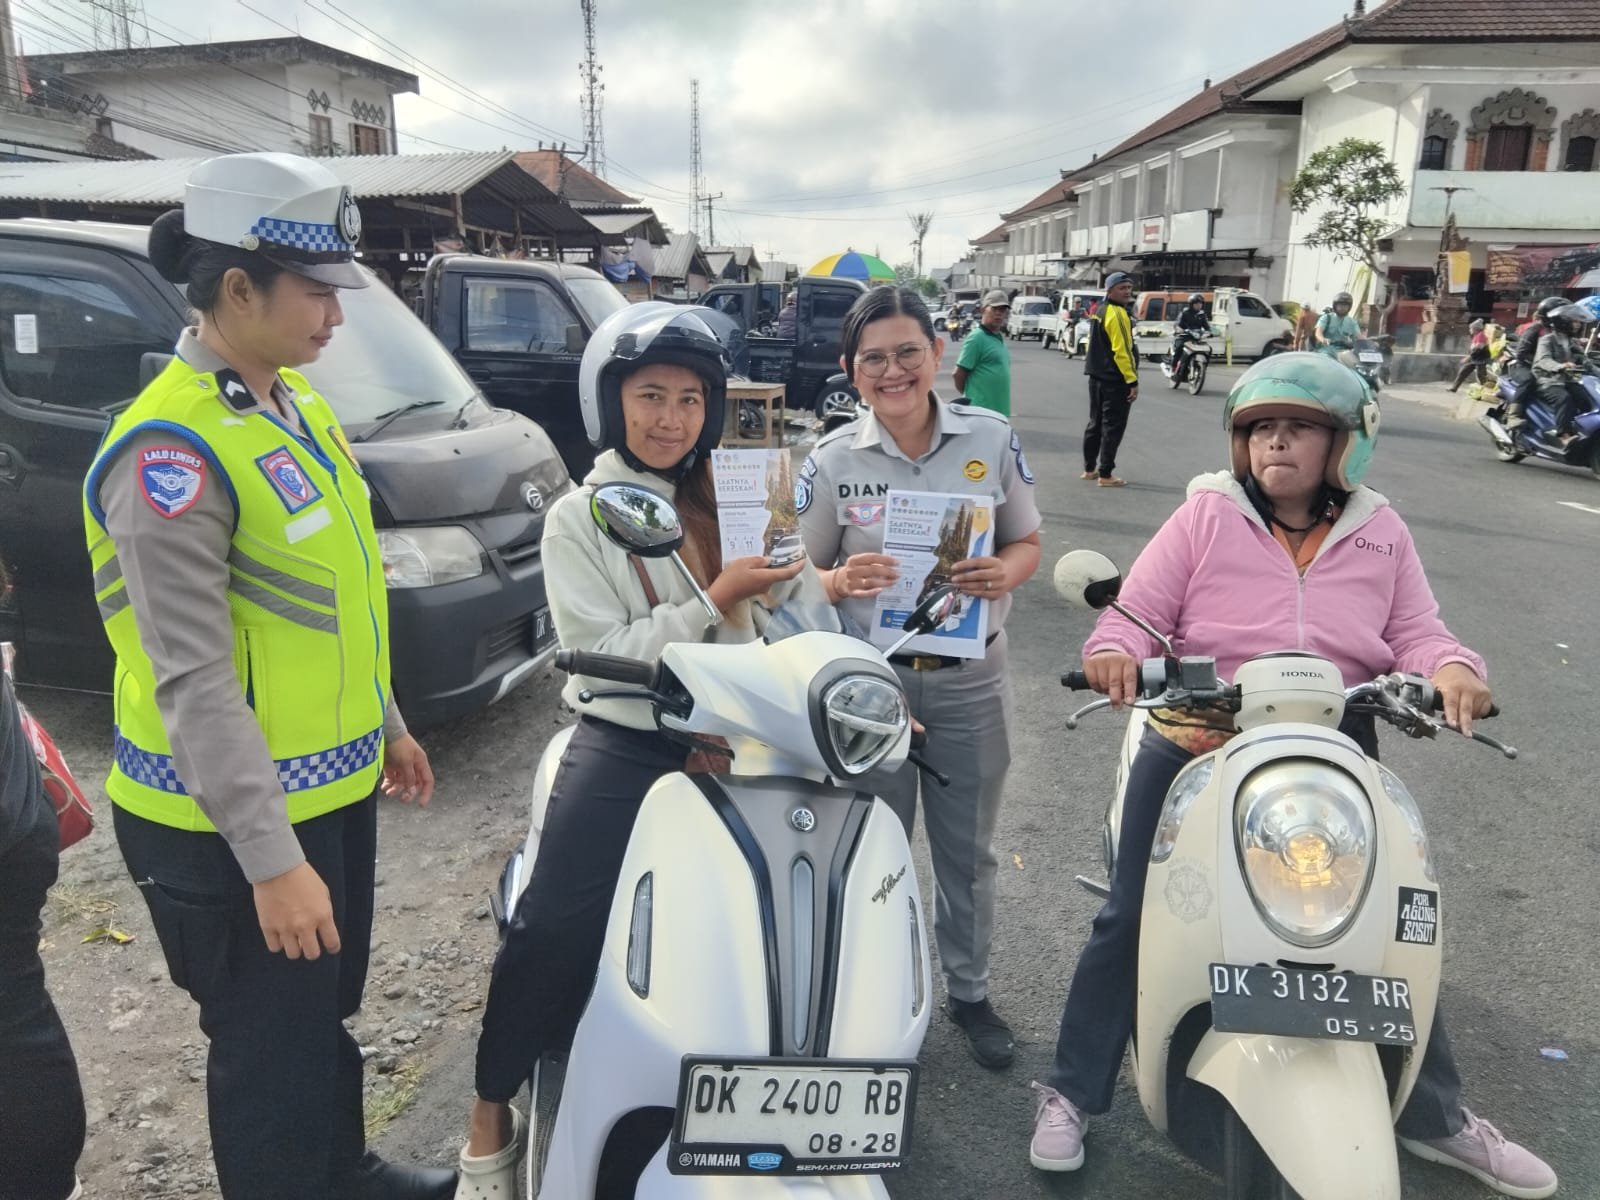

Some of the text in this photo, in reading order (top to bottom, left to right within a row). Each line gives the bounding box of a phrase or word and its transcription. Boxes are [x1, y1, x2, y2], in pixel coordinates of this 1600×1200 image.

[144, 449, 201, 468] LALU LINTAS
[1355, 537, 1393, 556] Onc.1
[1281, 671, 1324, 679] HONDA
[1401, 904, 1436, 922] AGUNG
[1213, 966, 1410, 1010] DK 3132 RR
[695, 1075, 902, 1115] DK 2400 RB
[693, 1153, 740, 1167] YAMAHA
[862, 1162, 901, 1170] DEPAN
